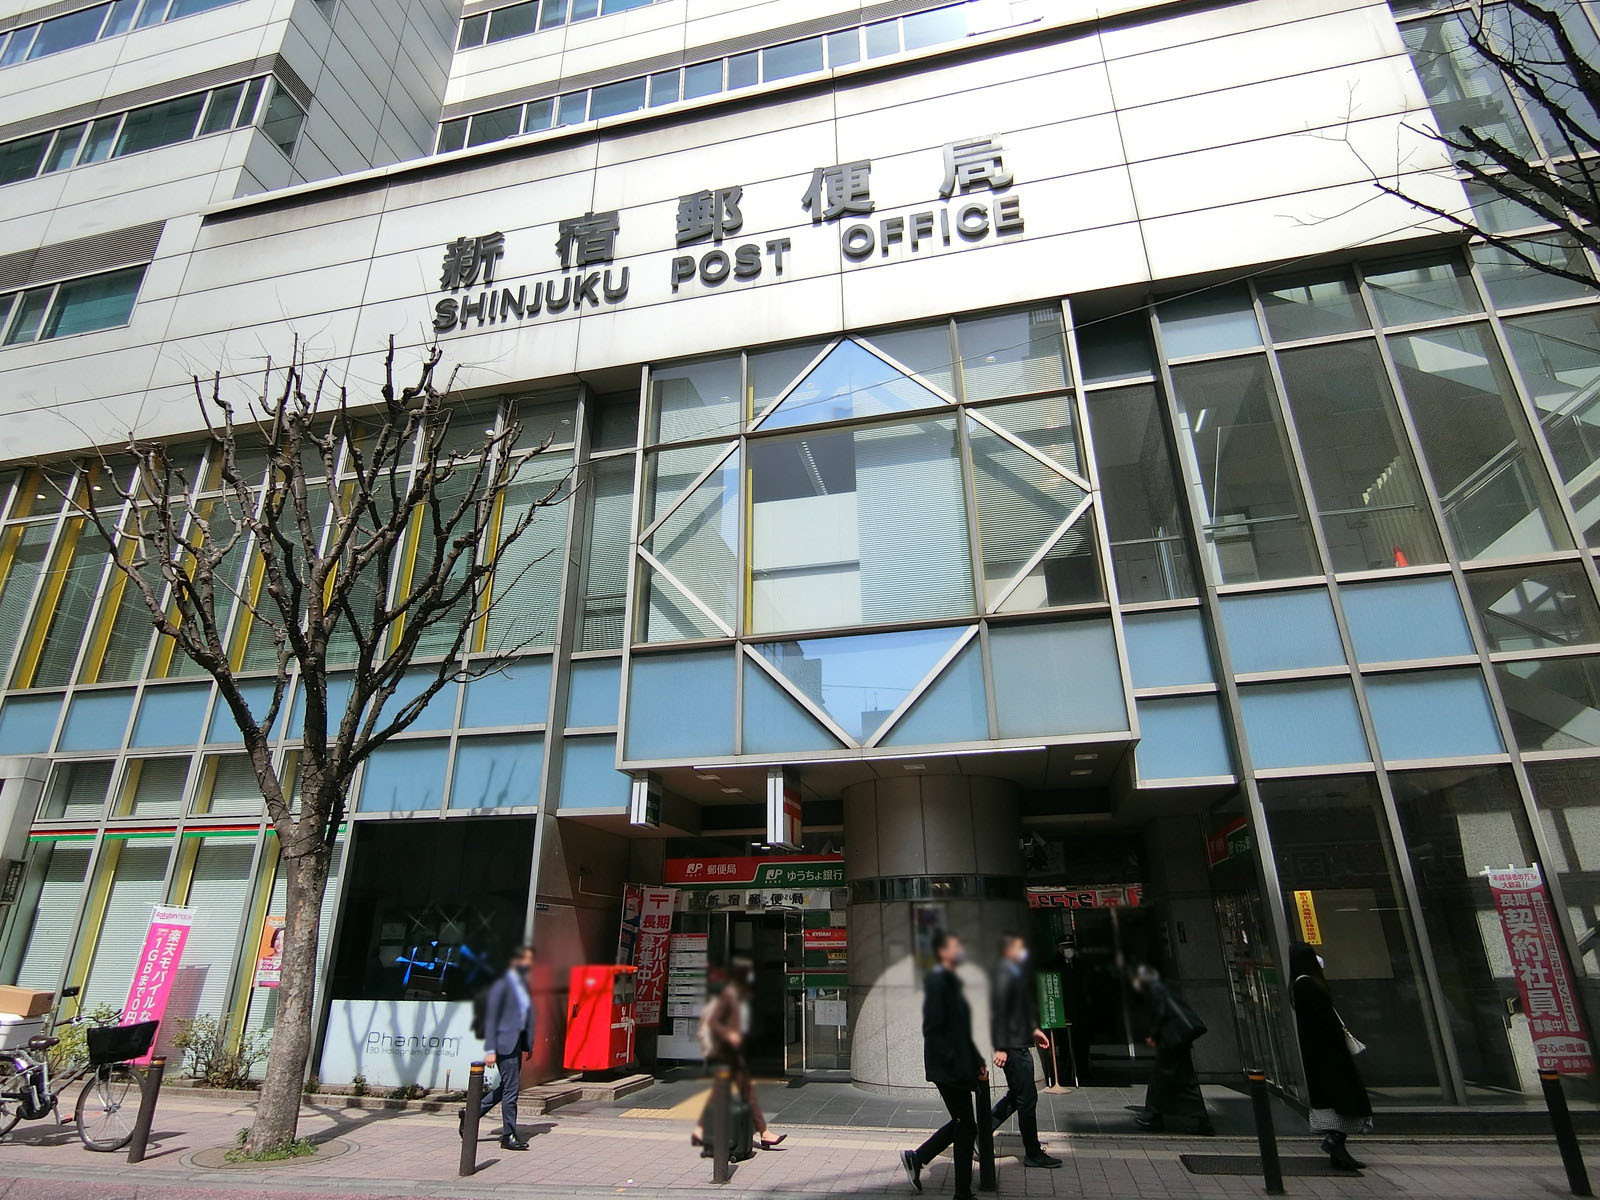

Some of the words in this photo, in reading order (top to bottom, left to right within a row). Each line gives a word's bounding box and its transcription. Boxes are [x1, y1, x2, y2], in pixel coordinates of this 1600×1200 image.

[440, 133, 1014, 291] 新宿郵便局
[432, 266, 630, 332] SHINJUKU
[671, 237, 791, 292] POST
[842, 195, 1025, 259] OFFICE
[707, 864, 737, 875] 郵便局
[787, 869, 843, 881] ゆうちょ銀行
[1500, 893, 1529, 907] 長期
[156, 911, 178, 920] Rakuten
[643, 915, 670, 929] 長期
[650, 934, 667, 1000] アルバイト
[1503, 908, 1560, 1017] 契約社員
[366, 1032, 460, 1056] Phantom
[1537, 1043, 1587, 1053] 安心の職場
[381, 1048, 422, 1056] Hologram
[425, 1048, 456, 1057] Display
